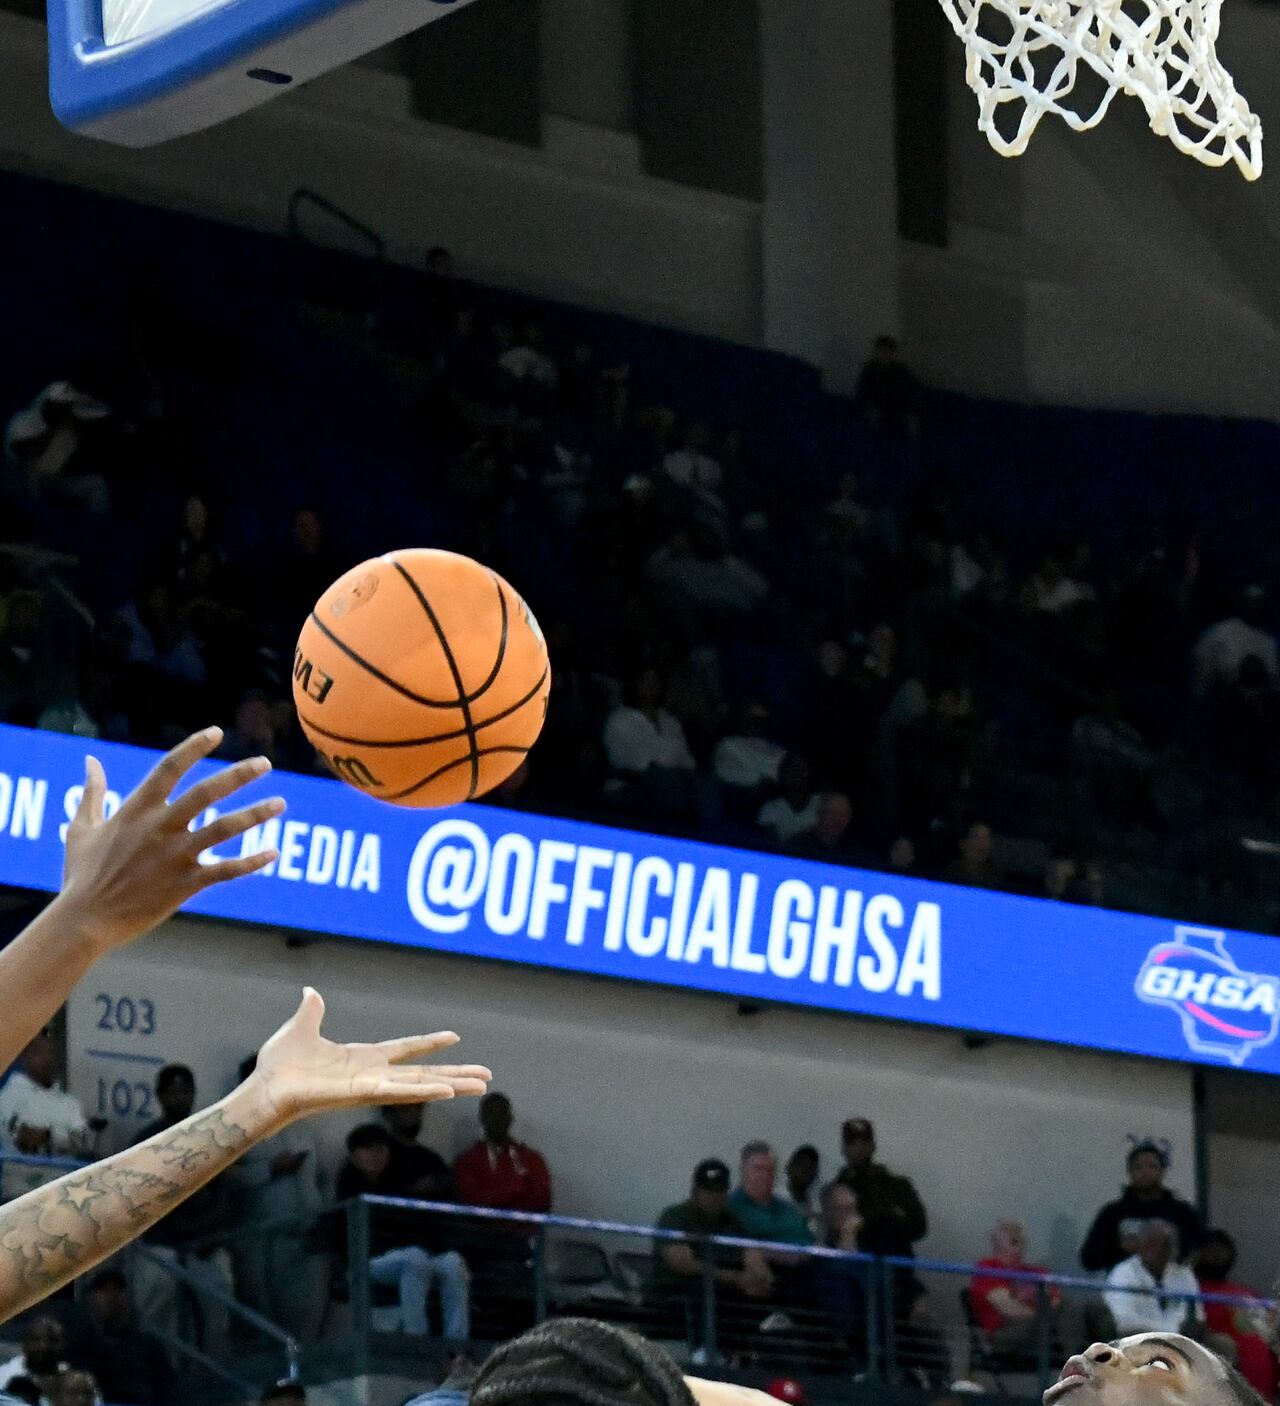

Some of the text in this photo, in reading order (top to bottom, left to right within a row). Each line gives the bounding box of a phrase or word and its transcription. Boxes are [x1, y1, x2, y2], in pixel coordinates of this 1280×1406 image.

[406, 818, 941, 1001] @OFFICIALGHSA
[1141, 965, 1276, 1015] GHSA
[95, 992, 156, 1036] 203
[96, 1076, 154, 1119] 102
